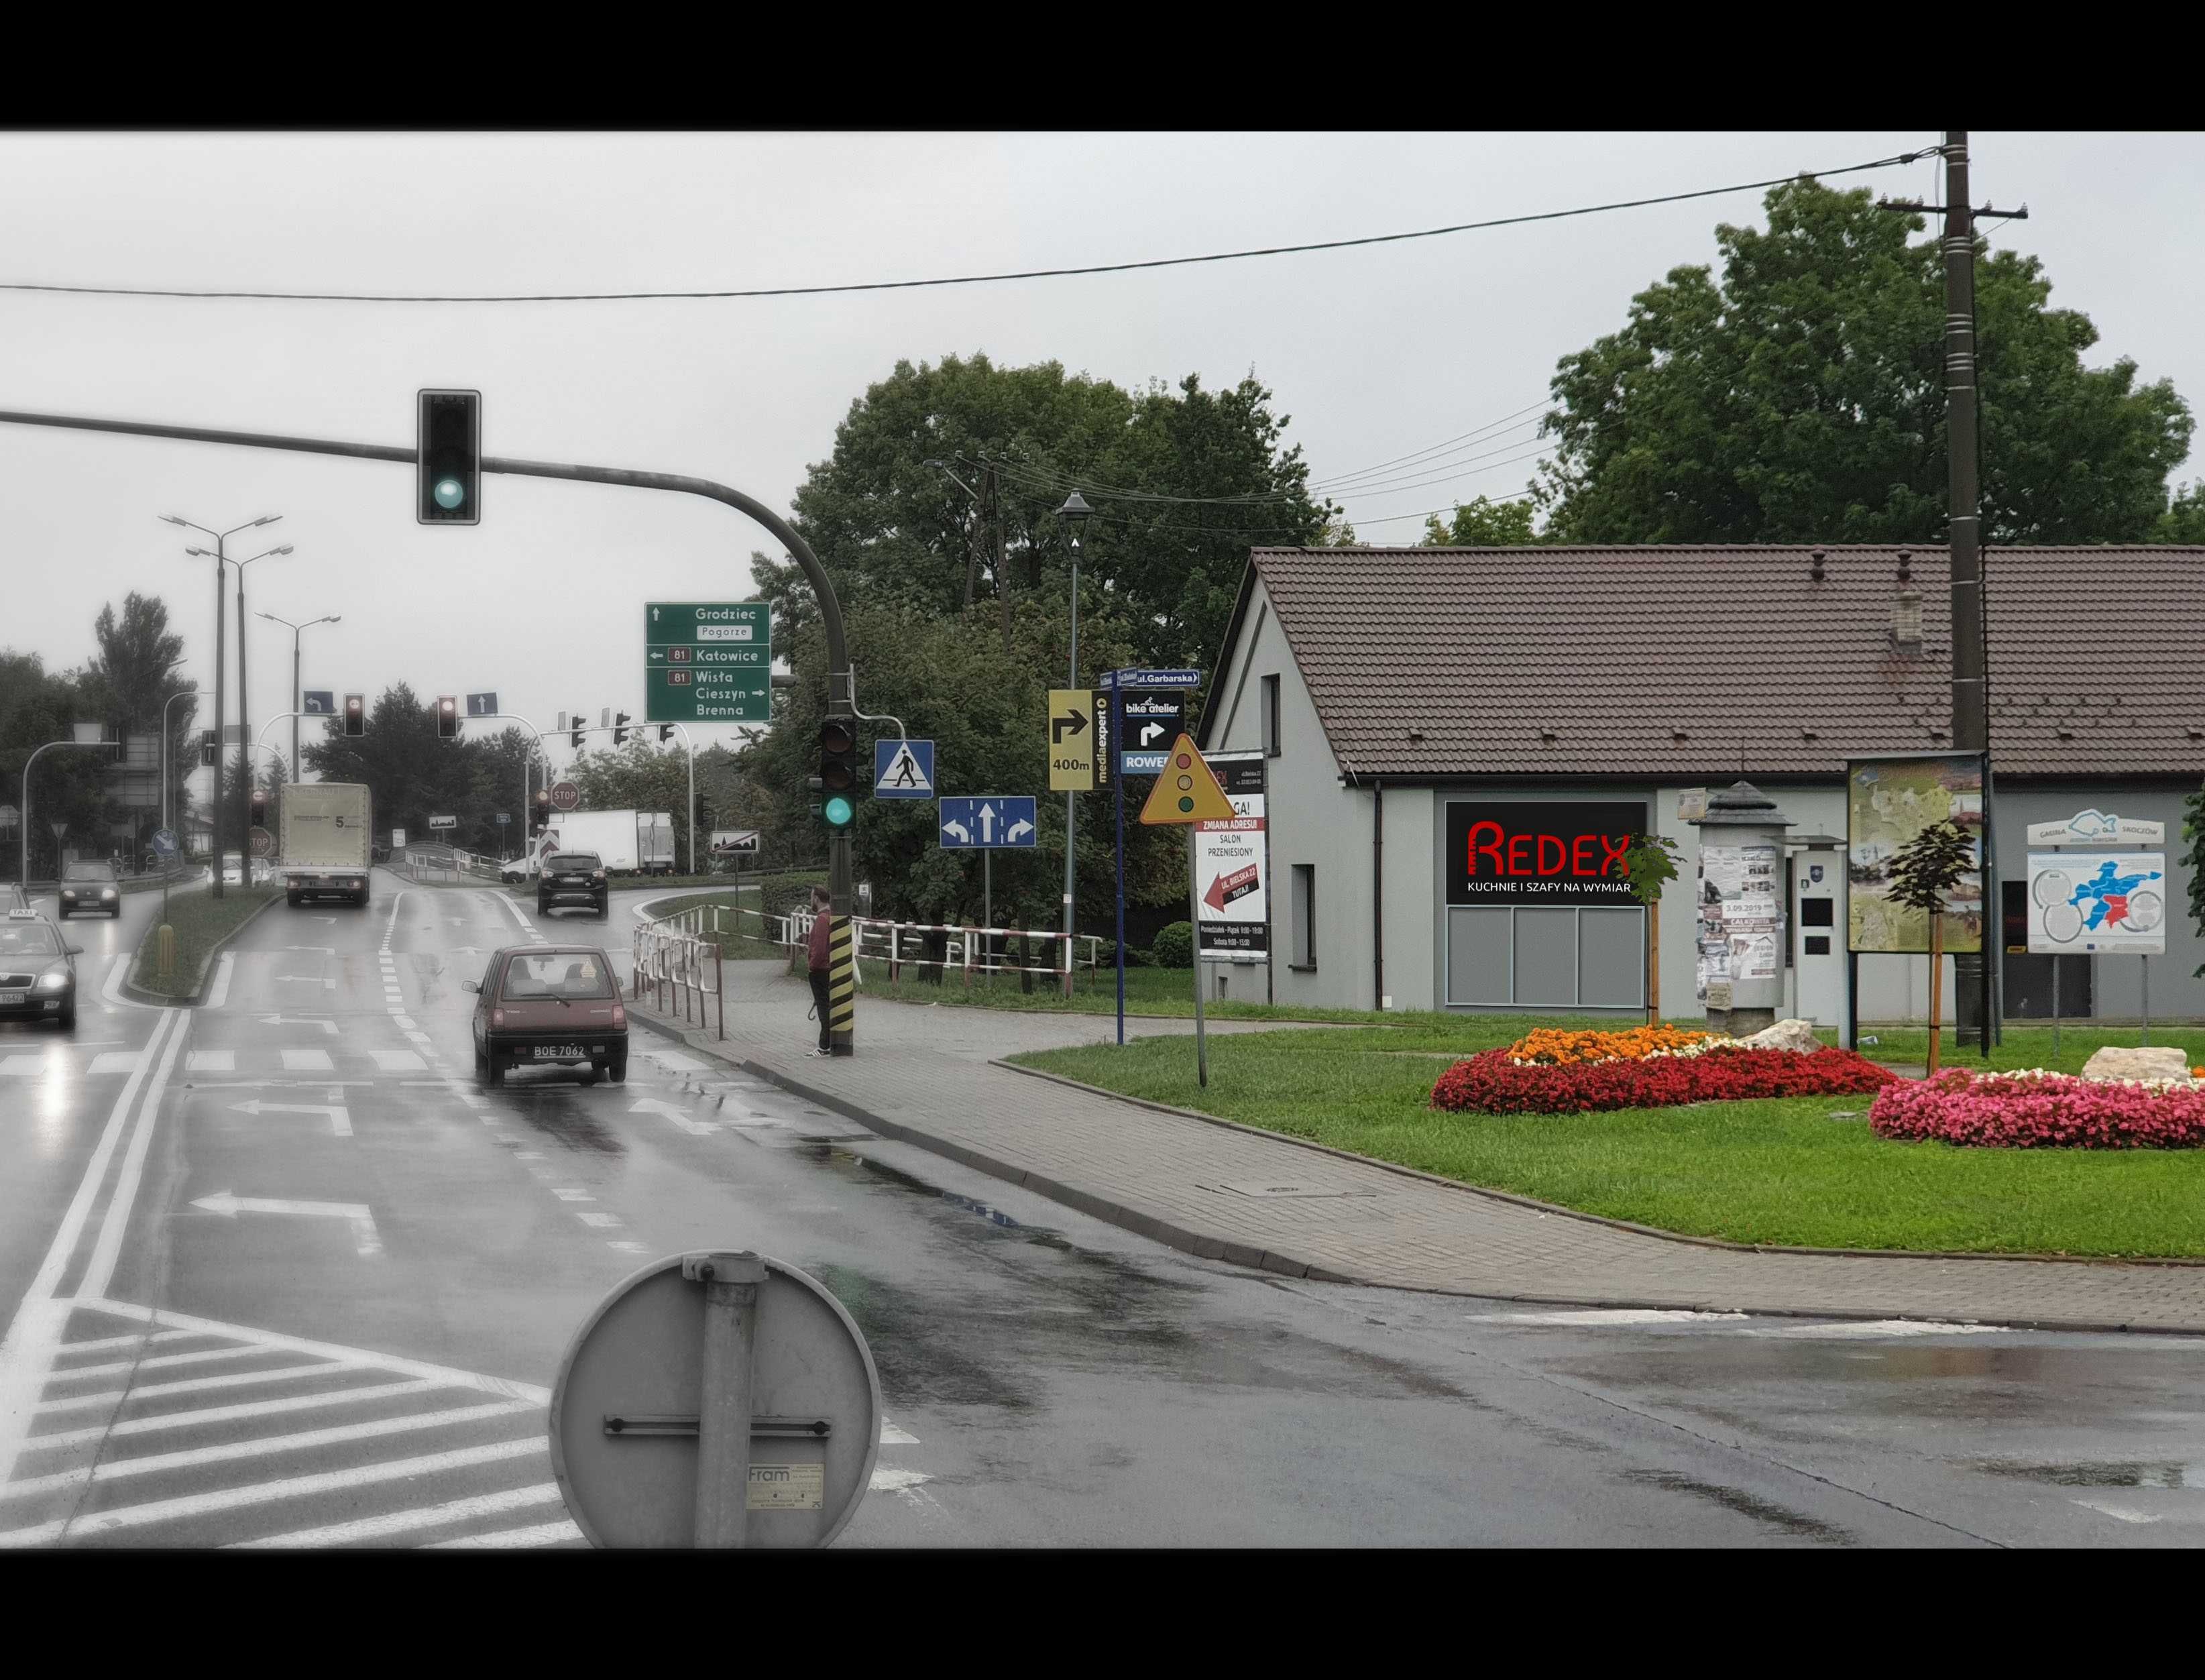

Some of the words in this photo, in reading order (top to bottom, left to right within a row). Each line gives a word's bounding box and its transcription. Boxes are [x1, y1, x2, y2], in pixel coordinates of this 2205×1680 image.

[695, 608, 756, 620] Grodziec
[702, 627, 747, 638] Pogórze
[674, 651, 685, 659] 81
[696, 650, 758, 661] Katowice
[674, 673, 685, 682] 81
[696, 671, 733, 683] Wisła
[695, 688, 746, 701] Cieszyn
[697, 705, 744, 715] Brenna
[1126, 703, 1146, 713] bike
[1149, 704, 1179, 713] atelier
[1096, 710, 1108, 783] mediaexpert
[1053, 759, 1090, 770] 400m
[555, 791, 575, 799] STOP
[336, 816, 344, 828] 5
[1203, 820, 1229, 830] ZMIANA
[1230, 820, 1257, 829] ADRESU!
[1220, 834, 1241, 844] SALON
[1208, 848, 1253, 856] PRZENIESIONY
[1468, 821, 1630, 876] REDEX
[1468, 883, 1517, 891] KUCHNIE
[1526, 883, 1561, 891] SZAFY
[1564, 883, 1579, 892] NA
[1583, 883, 1631, 892] WYMIAR
[559, 1046, 584, 1056] 7062
[748, 1467, 790, 1481] Fram
